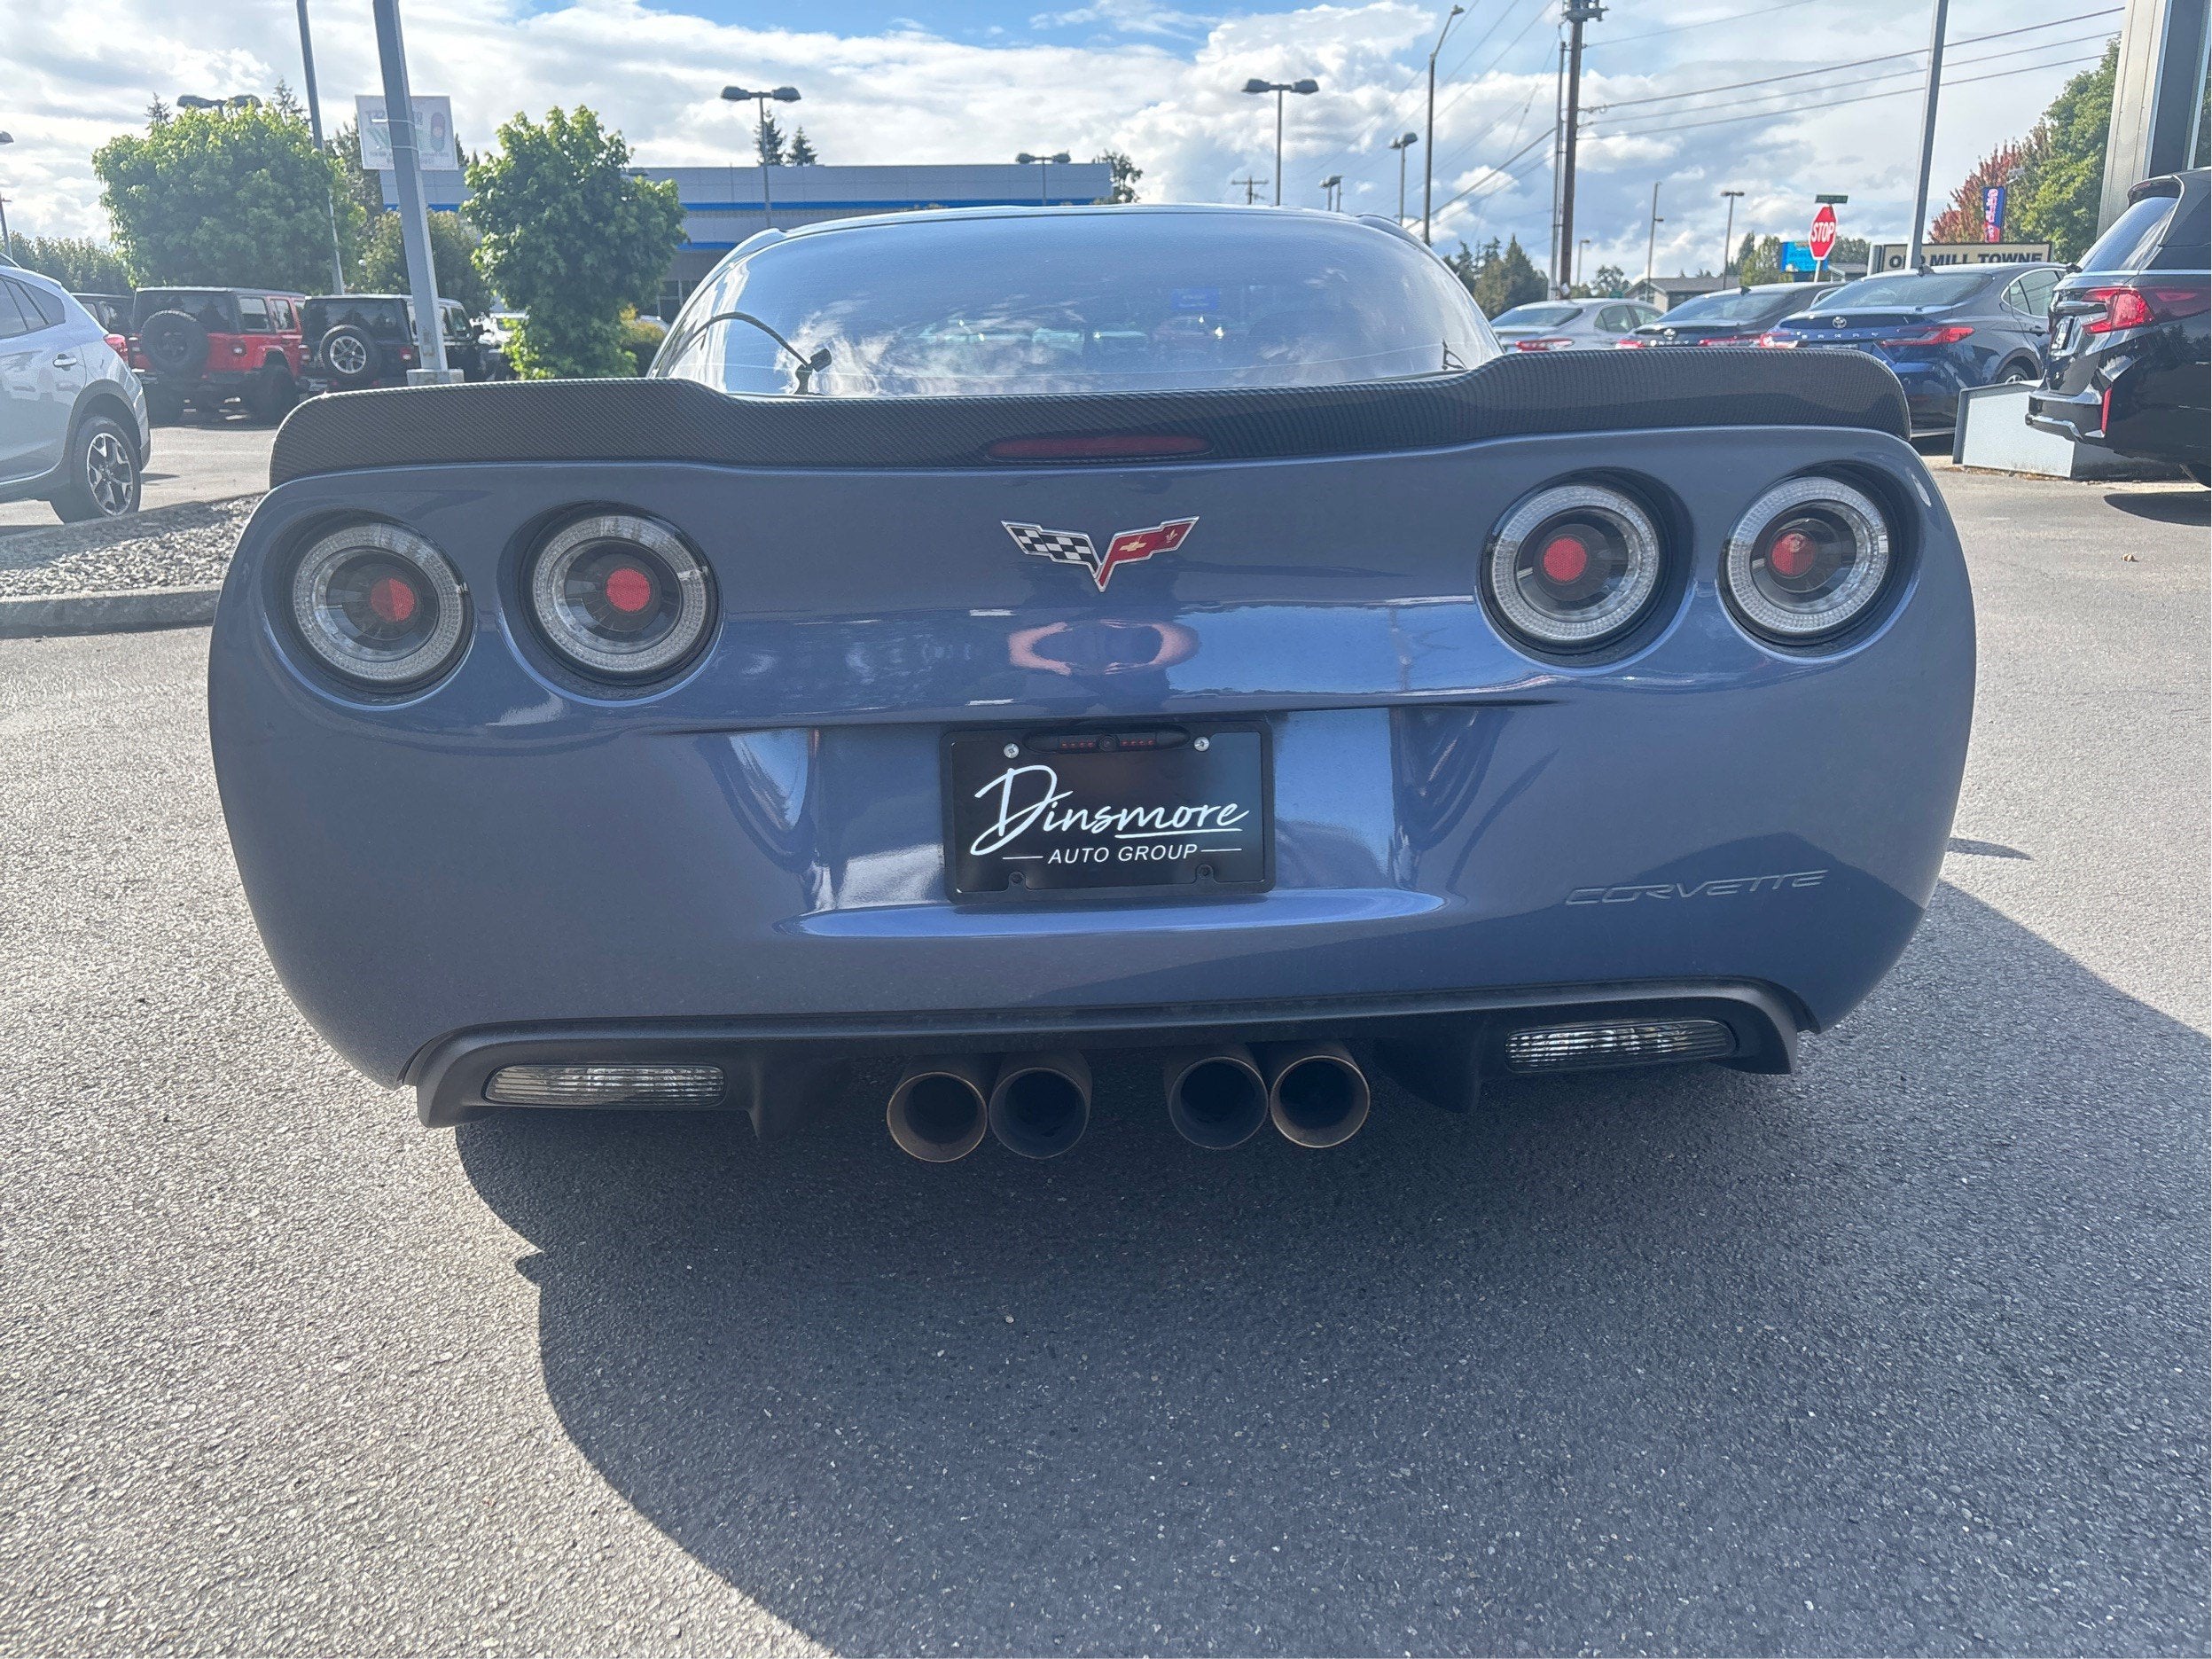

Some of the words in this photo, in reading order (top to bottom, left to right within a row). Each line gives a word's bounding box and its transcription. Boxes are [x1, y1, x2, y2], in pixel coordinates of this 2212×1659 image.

[1811, 221, 1835, 243] STOP
[1930, 254, 1968, 266] MILL
[970, 764, 1250, 856] Dinsmore
[1048, 847, 1109, 865] AUTO
[1118, 844, 1198, 862] GROUP
[1565, 869, 1830, 906] CORVETTE
